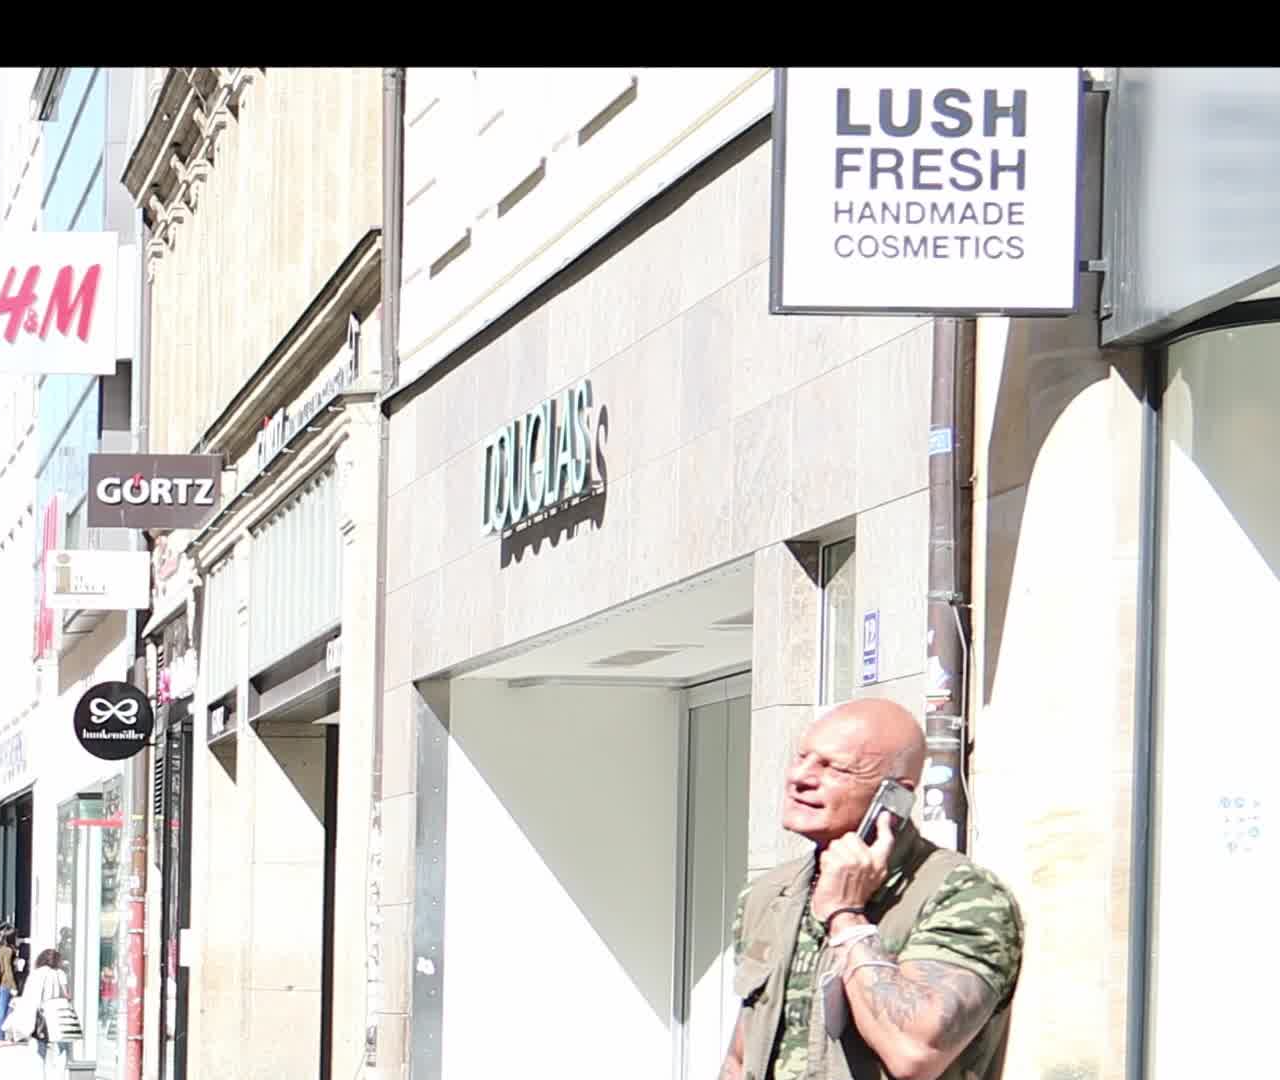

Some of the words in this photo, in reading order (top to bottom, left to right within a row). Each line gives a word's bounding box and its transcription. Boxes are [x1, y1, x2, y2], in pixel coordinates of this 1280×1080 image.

[836, 87, 1027, 138] LUSH
[835, 147, 1026, 192] FRESH
[834, 201, 1025, 226] HANDMADE
[834, 234, 1025, 260] COSMETICS
[480, 377, 593, 537] DOUGLAS
[82, 728, 146, 740] hunkemöller
